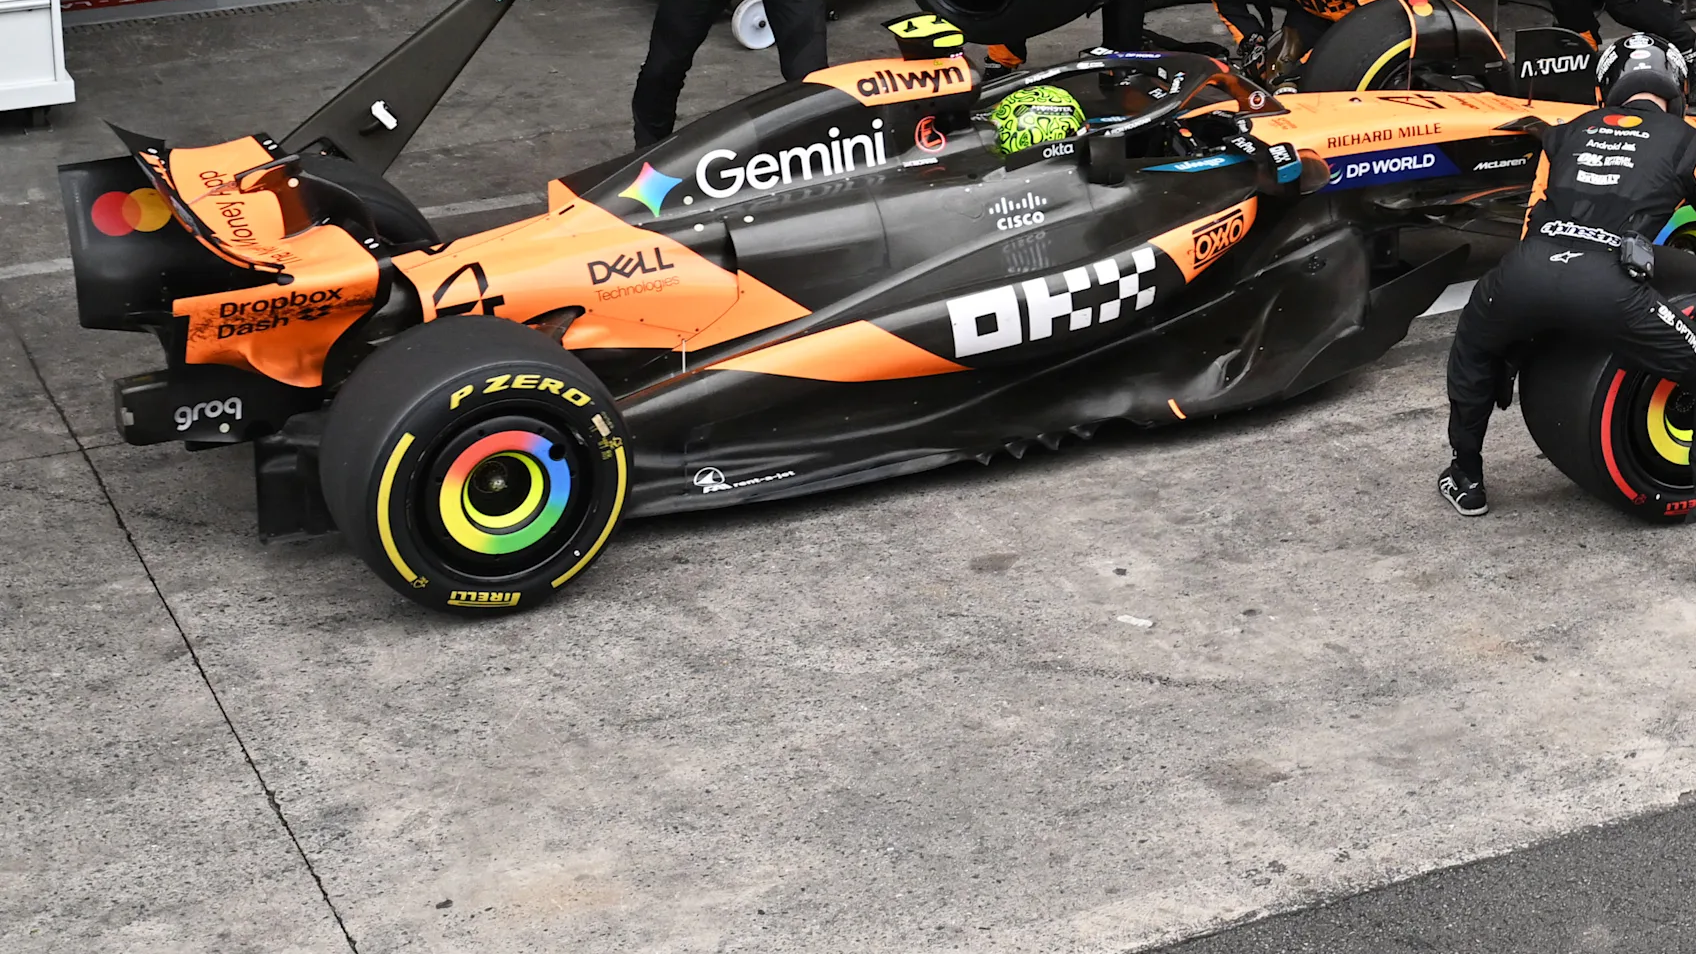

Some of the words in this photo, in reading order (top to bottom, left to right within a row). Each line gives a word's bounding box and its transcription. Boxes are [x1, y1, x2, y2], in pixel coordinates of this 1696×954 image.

[857, 66, 965, 96] allwyn
[1231, 137, 1257, 155] FxPro
[1327, 129, 1393, 148] RICHARD
[1398, 123, 1443, 138] MILLE
[1586, 139, 1622, 150] Android
[1614, 130, 1650, 139] WORLD
[696, 118, 887, 199] Gemini
[1043, 143, 1074, 158] okta
[1347, 161, 1370, 178] DP
[1371, 154, 1436, 175] WORLD
[1473, 157, 1526, 171] McLaren
[216, 200, 257, 248] Money
[997, 210, 1045, 231] cisco
[1541, 220, 1622, 247] alpinestars
[1195, 217, 1244, 262] OXXO
[587, 247, 674, 285] DELL
[595, 273, 680, 303] Technologies
[220, 288, 344, 318] Dropbox
[946, 247, 1156, 358] OKX
[217, 315, 289, 339] Dash
[450, 385, 474, 410] P
[483, 374, 592, 407] ZERO
[174, 397, 243, 433] groq
[732, 470, 796, 488] rent-a-jet
[447, 591, 521, 607] PIRELLI
